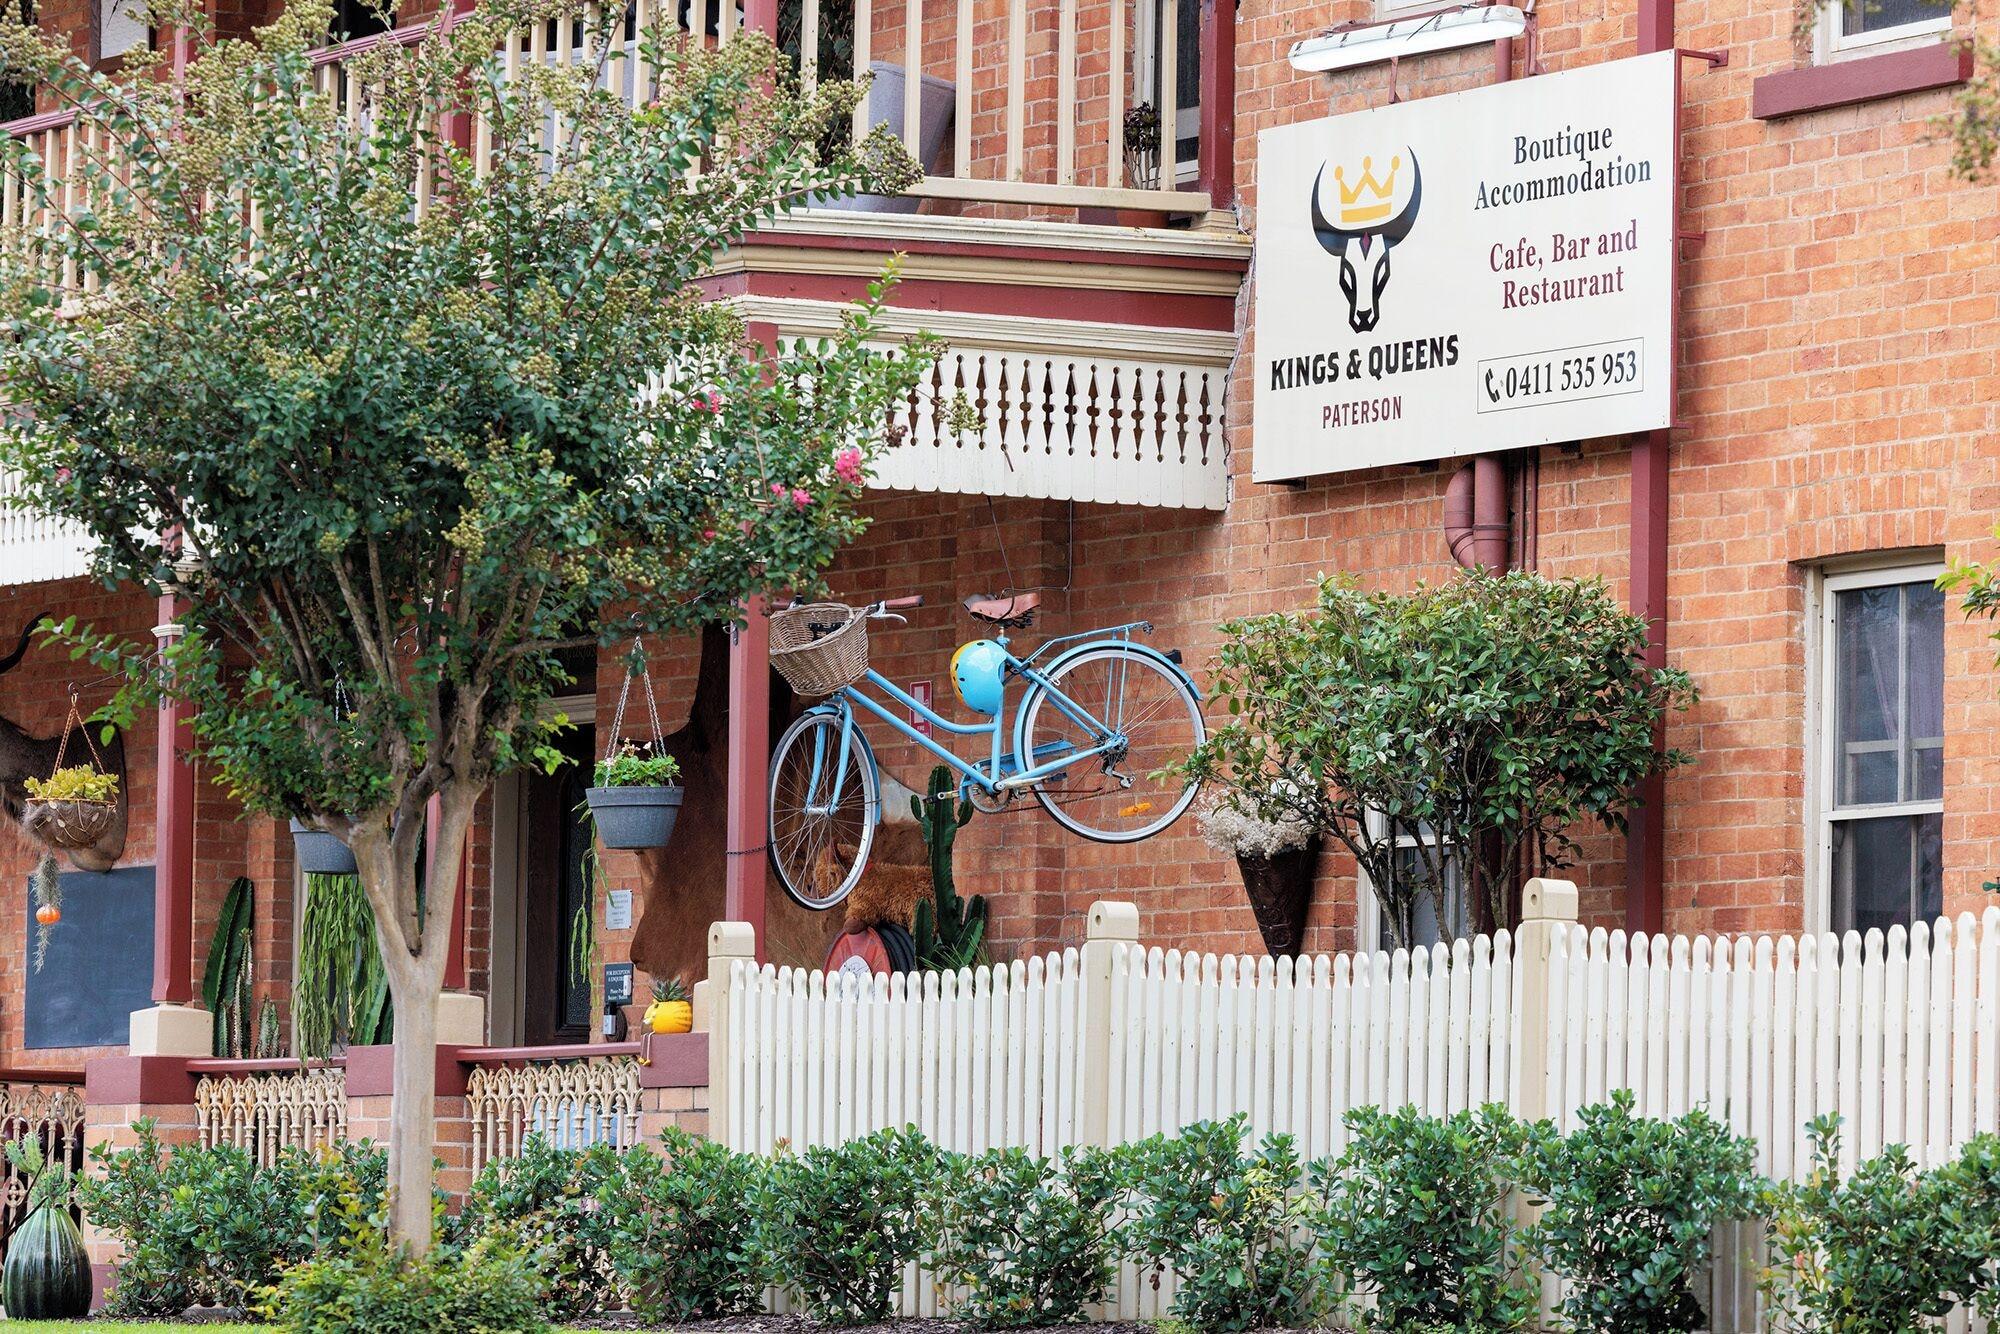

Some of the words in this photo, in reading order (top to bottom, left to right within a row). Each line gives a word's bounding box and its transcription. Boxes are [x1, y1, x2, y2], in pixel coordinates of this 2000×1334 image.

[1513, 125, 1613, 165] Boutique
[1474, 155, 1652, 211] Accommodation
[1490, 238, 1544, 273] Cafe,
[1551, 233, 1590, 263] Bar
[1597, 220, 1638, 256] and
[1502, 266, 1625, 310] Restaurant
[1270, 351, 1340, 391] KINGS
[1346, 348, 1363, 381] &
[1368, 335, 1459, 382] QUEENS
[1505, 362, 1553, 399] 0411
[1560, 356, 1596, 393] 535
[1602, 350, 1637, 386] 953
[1322, 395, 1402, 429] PATERSON
